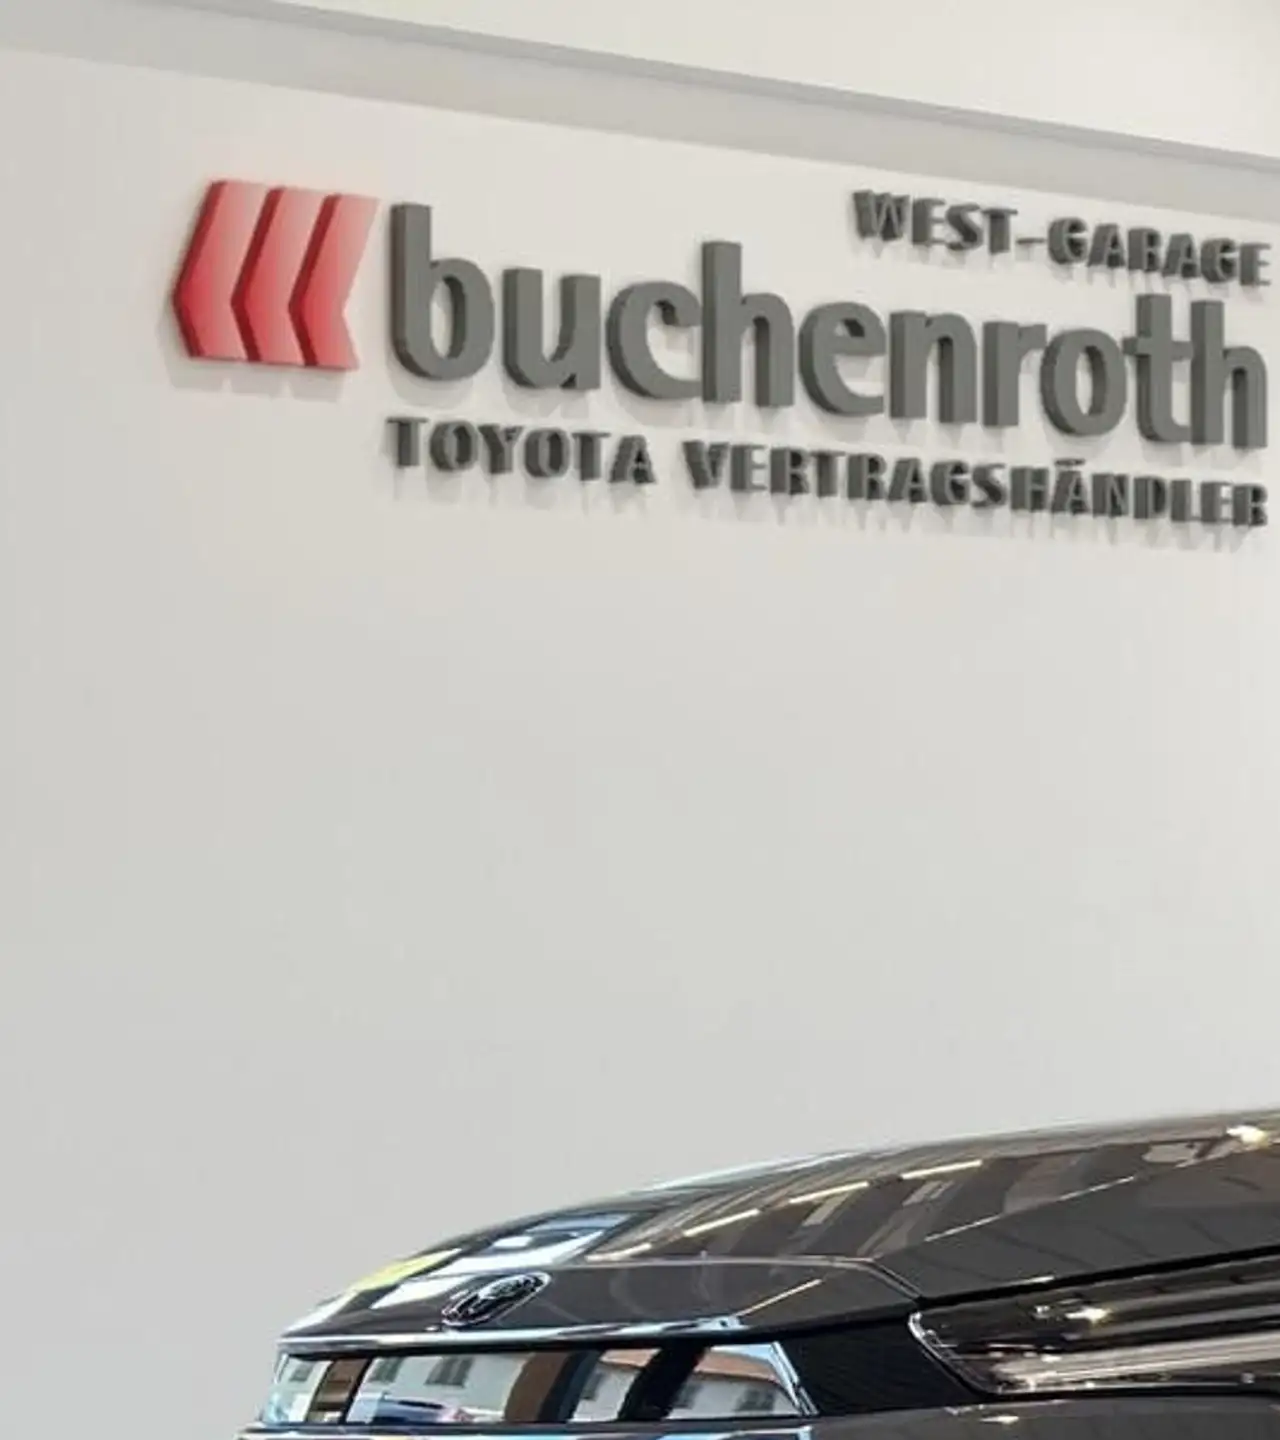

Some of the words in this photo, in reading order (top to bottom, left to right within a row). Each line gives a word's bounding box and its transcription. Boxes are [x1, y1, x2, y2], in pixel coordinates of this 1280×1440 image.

[853, 189, 1271, 286] WEST-GARAGE
[389, 202, 1268, 449] buchenroth
[386, 416, 657, 485] TOYOTA
[682, 438, 1268, 527] VERTRAGSHÄNDLER
